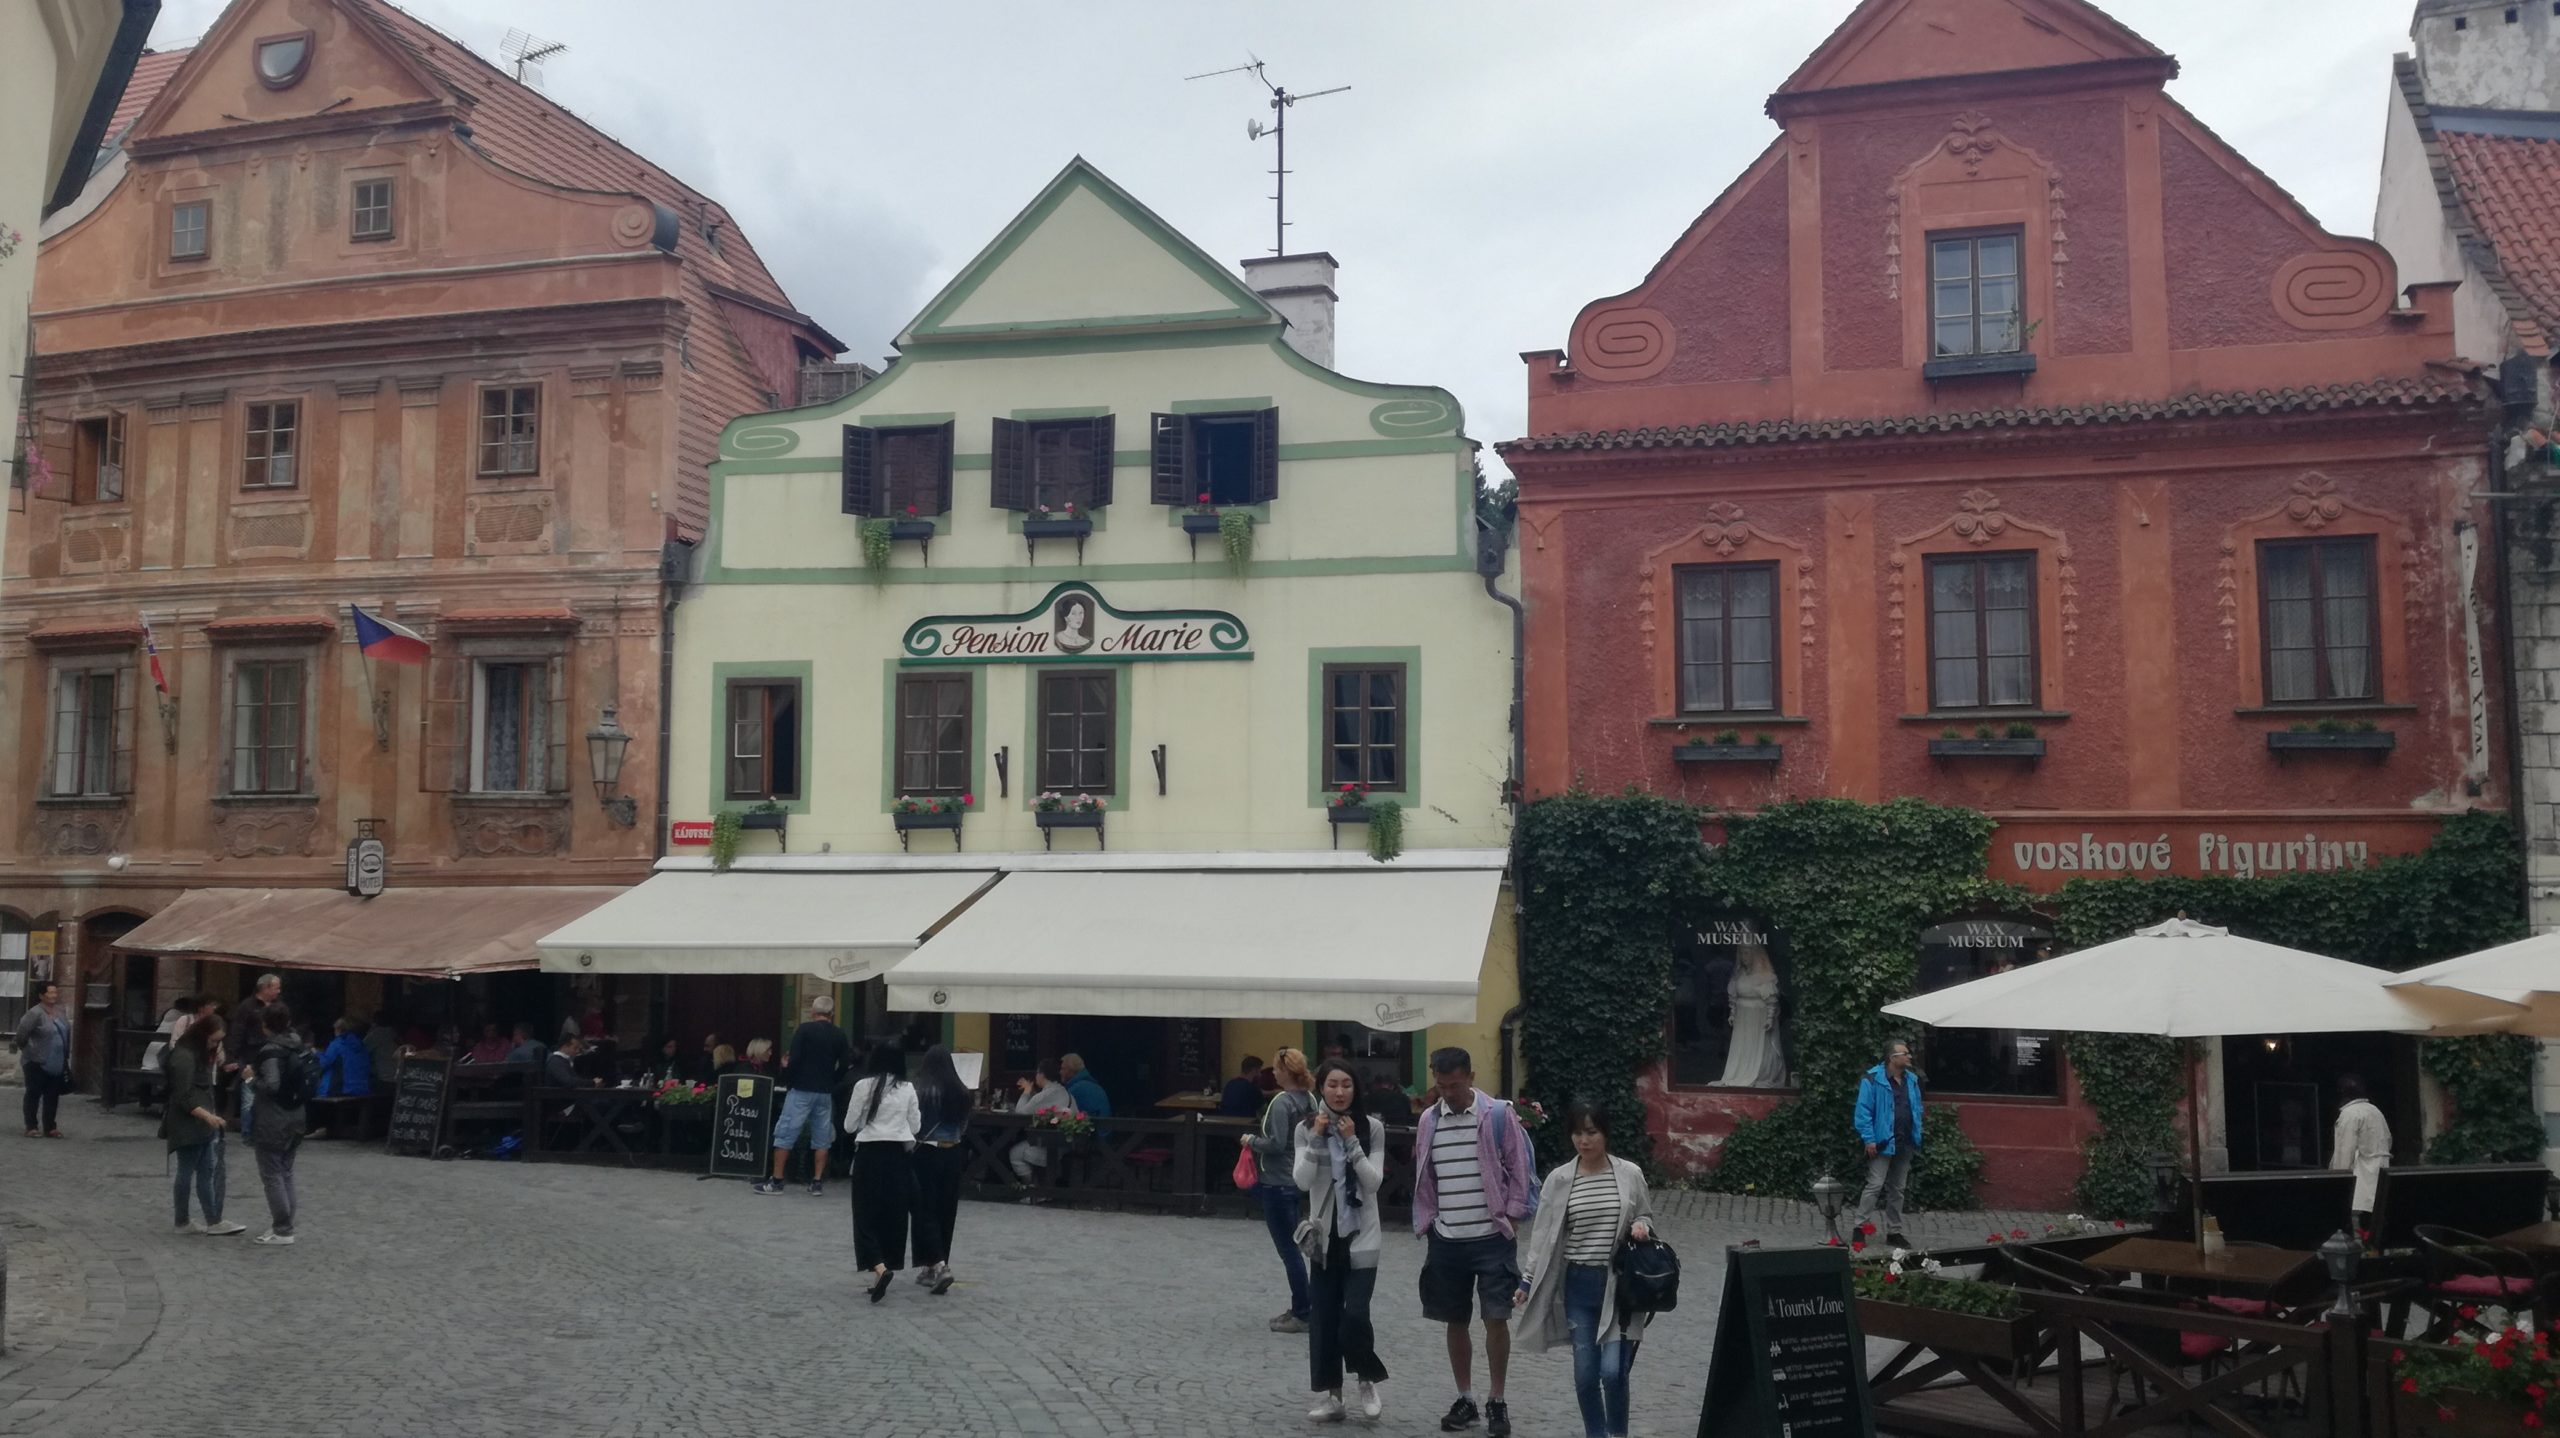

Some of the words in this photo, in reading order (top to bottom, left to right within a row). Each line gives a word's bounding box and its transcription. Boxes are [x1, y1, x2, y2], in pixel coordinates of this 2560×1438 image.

[942, 624, 1050, 656] Pension
[1100, 622, 1203, 652] Marie
[2013, 832, 2172, 871] voskové
[2199, 832, 2368, 880] figuriny
[348, 850, 357, 885] HOTEL
[360, 876, 381, 889] HOTEL
[1713, 921, 1750, 933] WAX
[1966, 923, 2005, 936] WAX
[1696, 932, 1769, 945] MUSEUM
[1948, 935, 2024, 948] MUSEUM
[726, 1094, 759, 1118] Pizza
[723, 1117, 752, 1139] Pasta
[720, 1139, 754, 1162] Salads
[1775, 1298, 1816, 1318] Tourist
[1816, 1296, 1845, 1315] Zone
